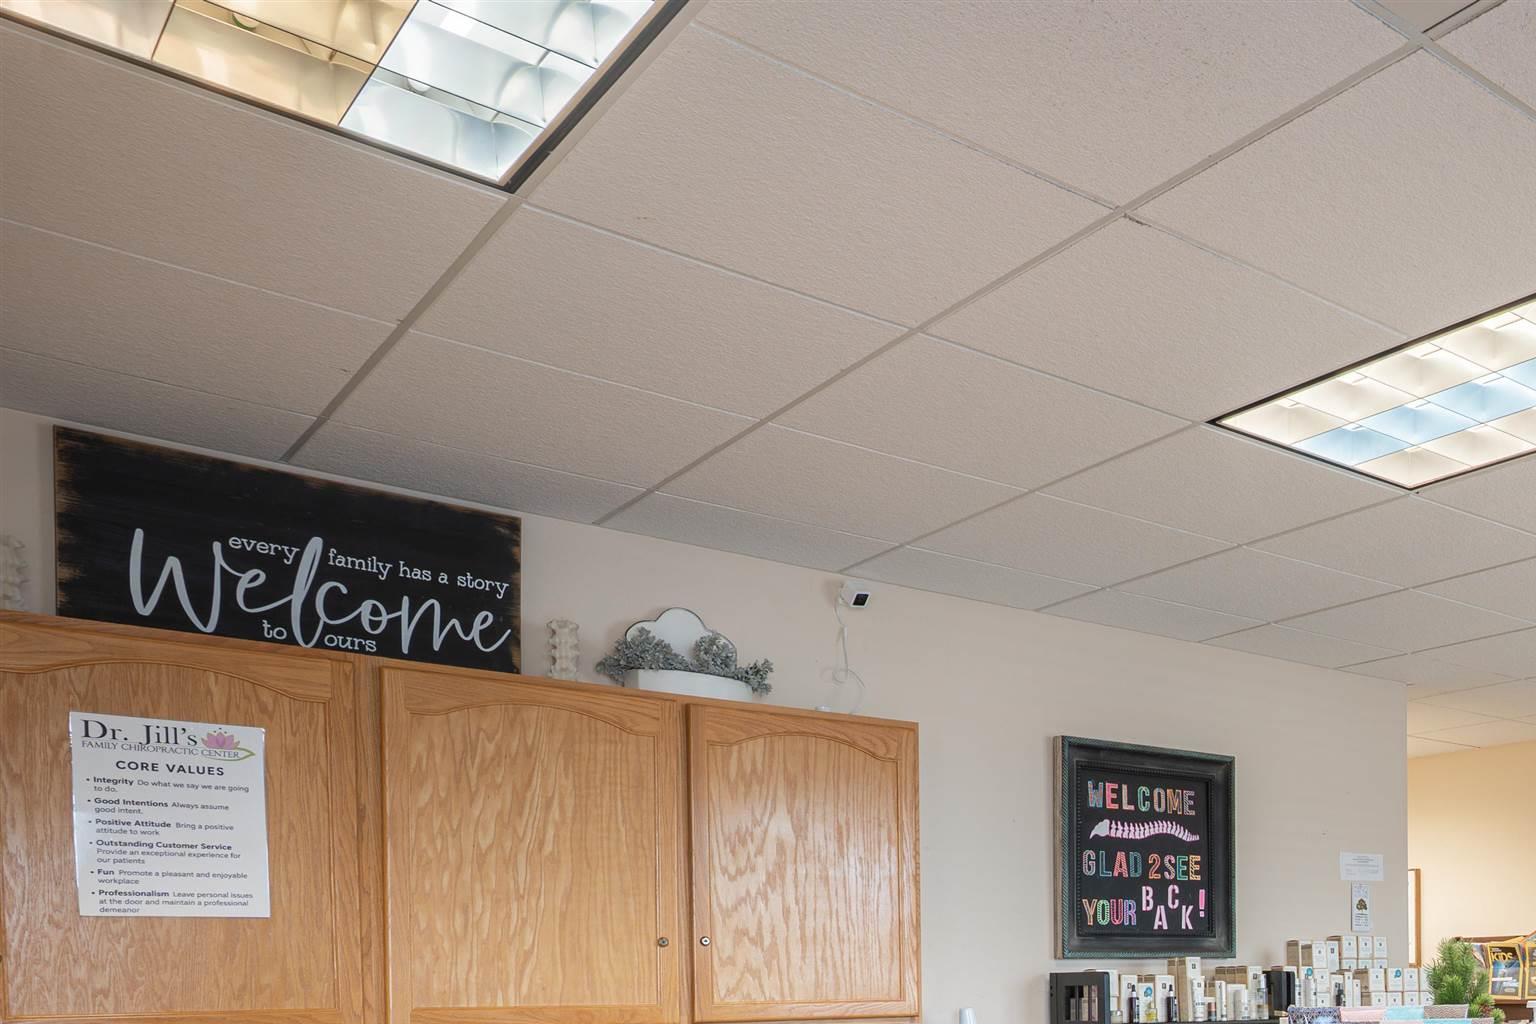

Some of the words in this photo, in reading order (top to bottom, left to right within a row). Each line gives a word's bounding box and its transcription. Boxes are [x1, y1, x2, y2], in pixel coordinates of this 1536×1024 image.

[228, 535, 300, 564] every
[328, 549, 392, 580] family
[399, 561, 431, 581] has
[438, 572, 449, 585] a
[457, 572, 509, 598] story
[129, 528, 511, 654] Welcome
[263, 620, 287, 640] to
[324, 634, 377, 652] ours
[80, 719, 128, 741] Dr.
[139, 724, 197, 746] Jill's
[82, 740, 118, 750] FAMILY
[121, 743, 198, 756] CHIROPRACTIC
[201, 750, 240, 758] CENTER
[116, 760, 159, 772] CORE
[166, 764, 224, 776] VALUES
[93, 777, 133, 786] Integrity
[123, 799, 168, 807] Intentions
[172, 802, 199, 810] Always
[1088, 780, 1195, 816] WELCOME
[134, 820, 171, 828] Attitude
[96, 839, 153, 848] Outstanding
[141, 850, 186, 858] exceptional
[1083, 850, 1142, 878] GLAD
[1082, 898, 1136, 925] YOUR
[1491, 952, 1512, 961] KIDS
